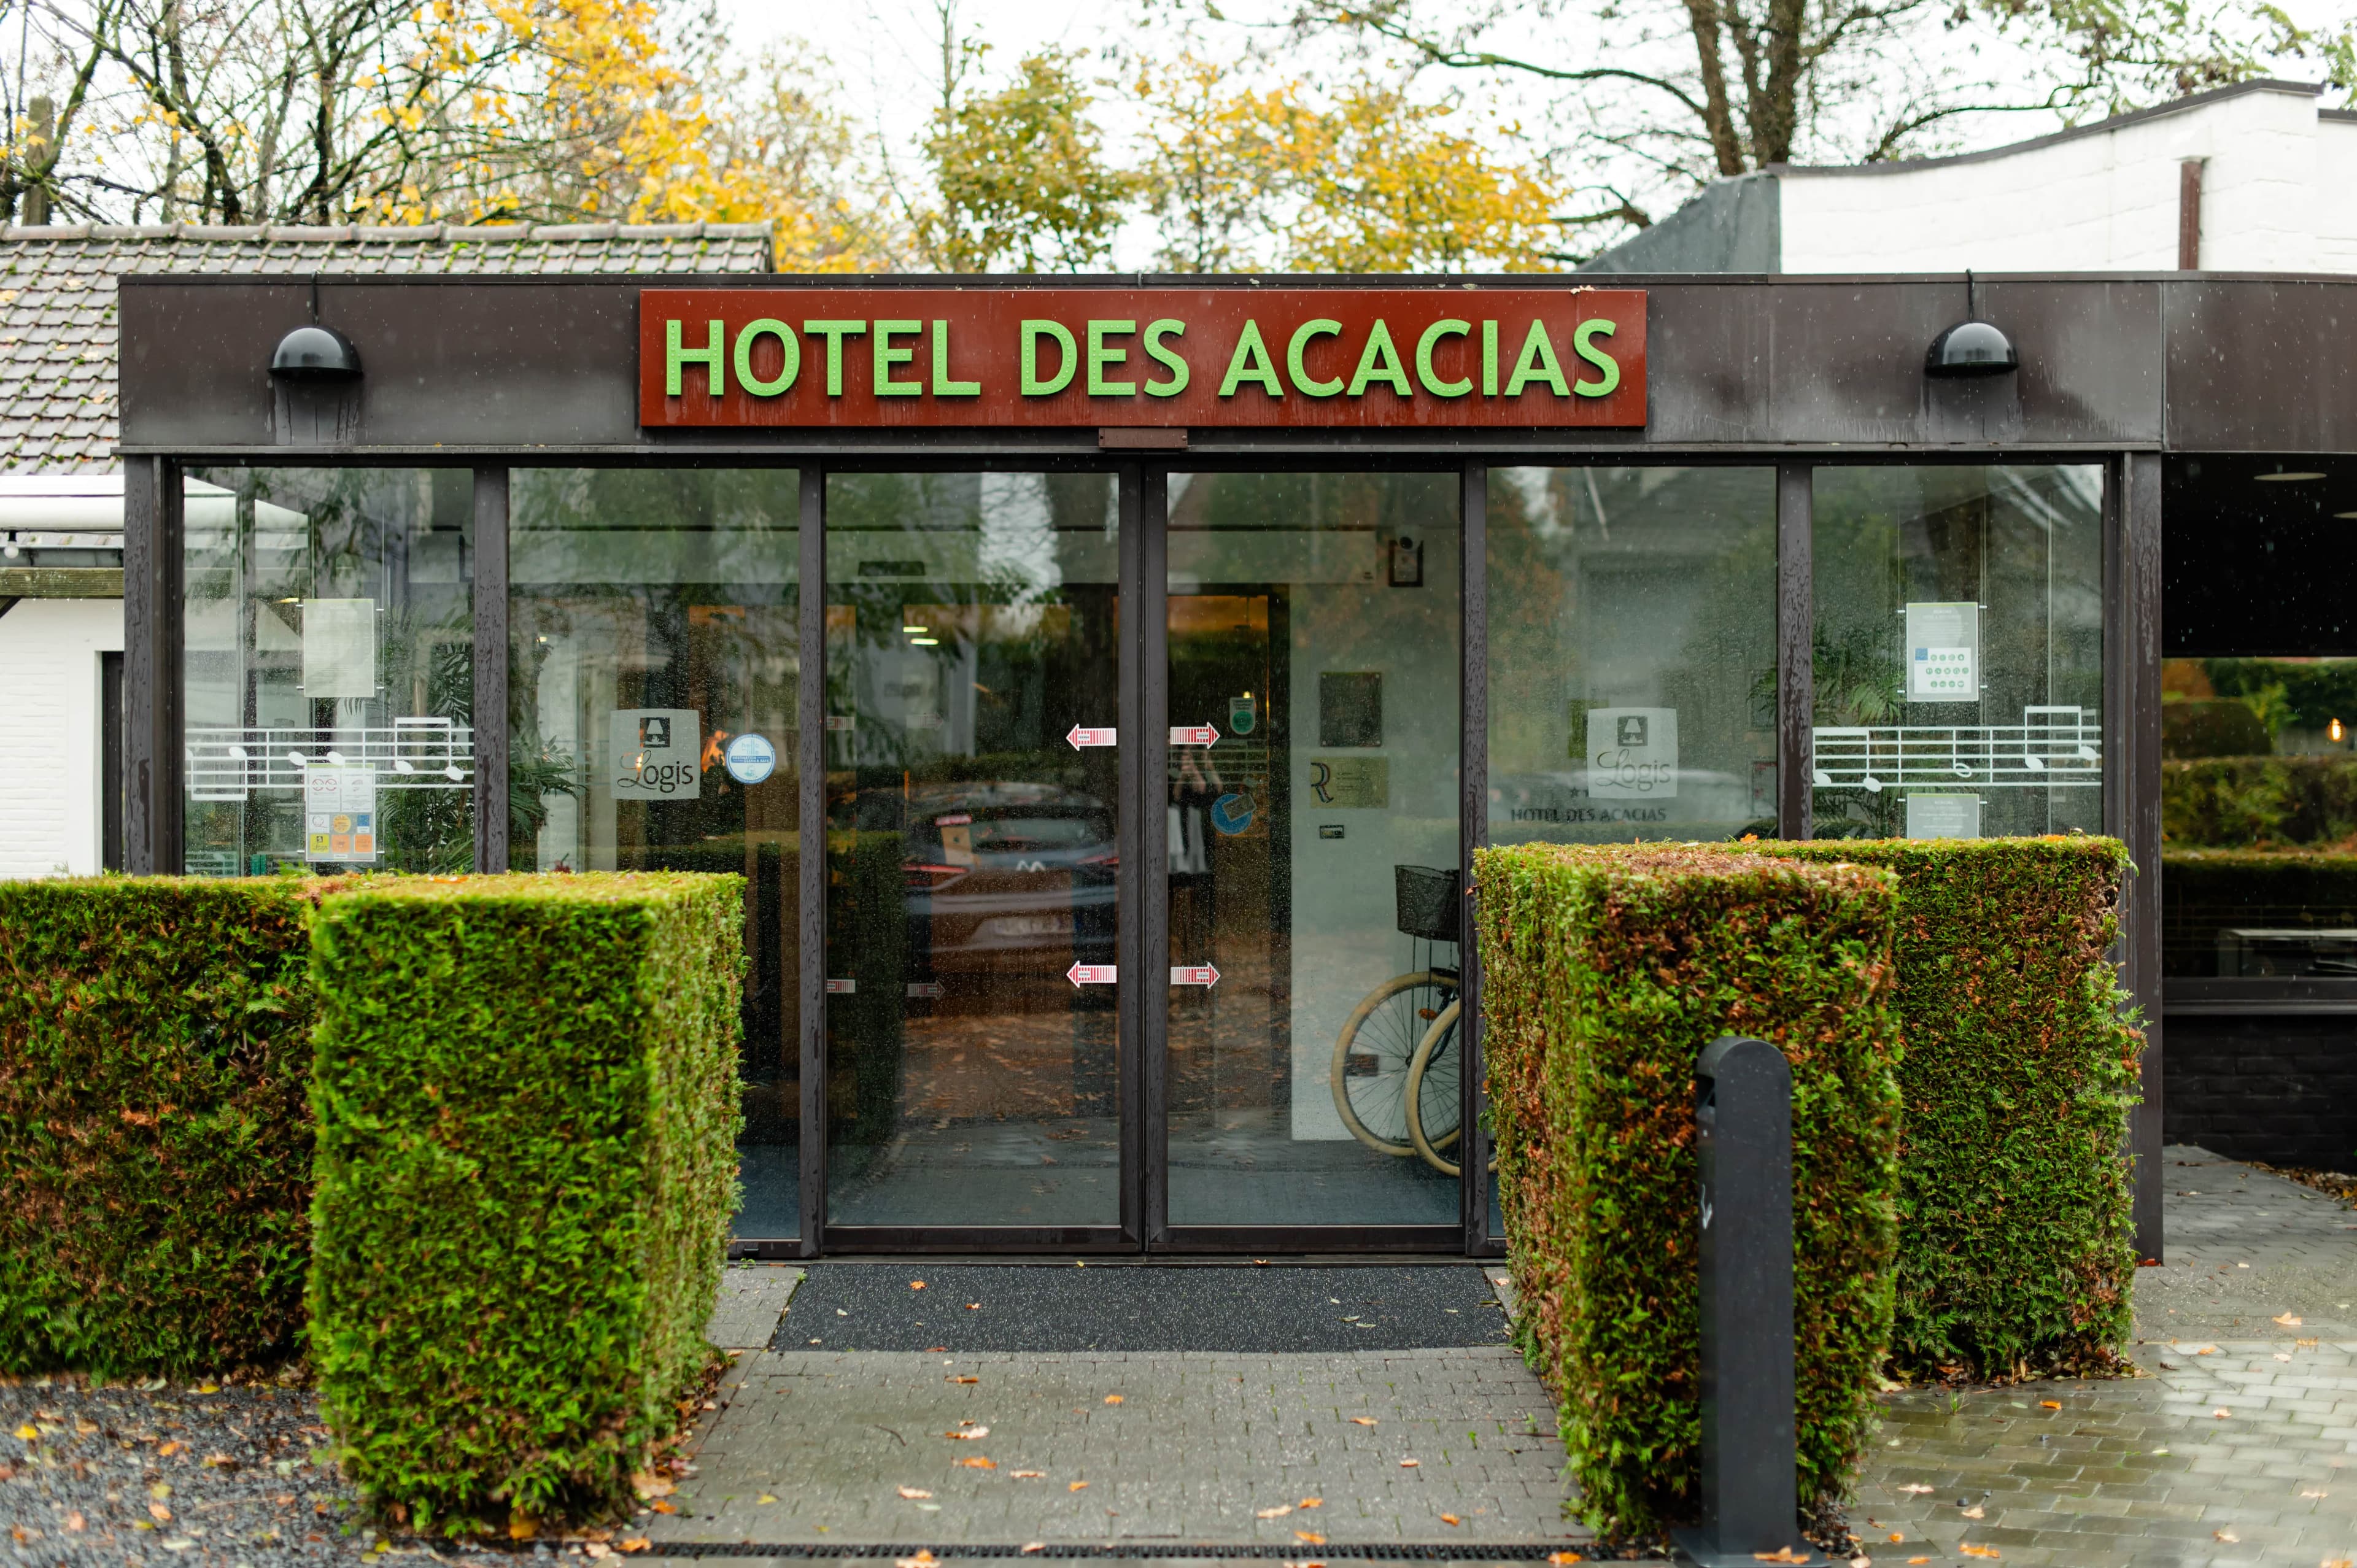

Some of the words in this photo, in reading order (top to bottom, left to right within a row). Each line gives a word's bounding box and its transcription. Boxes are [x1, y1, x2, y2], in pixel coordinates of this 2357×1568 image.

[666, 319, 981, 396] HOTEL
[1020, 319, 1190, 396] DES
[1218, 319, 1620, 396] ACACIAS
[617, 749, 694, 793] Logis
[1596, 748, 1671, 791] Logis
[1511, 808, 1560, 821] HOTEL
[1566, 808, 1595, 822] DES
[1600, 808, 1666, 821] ACACIAS
